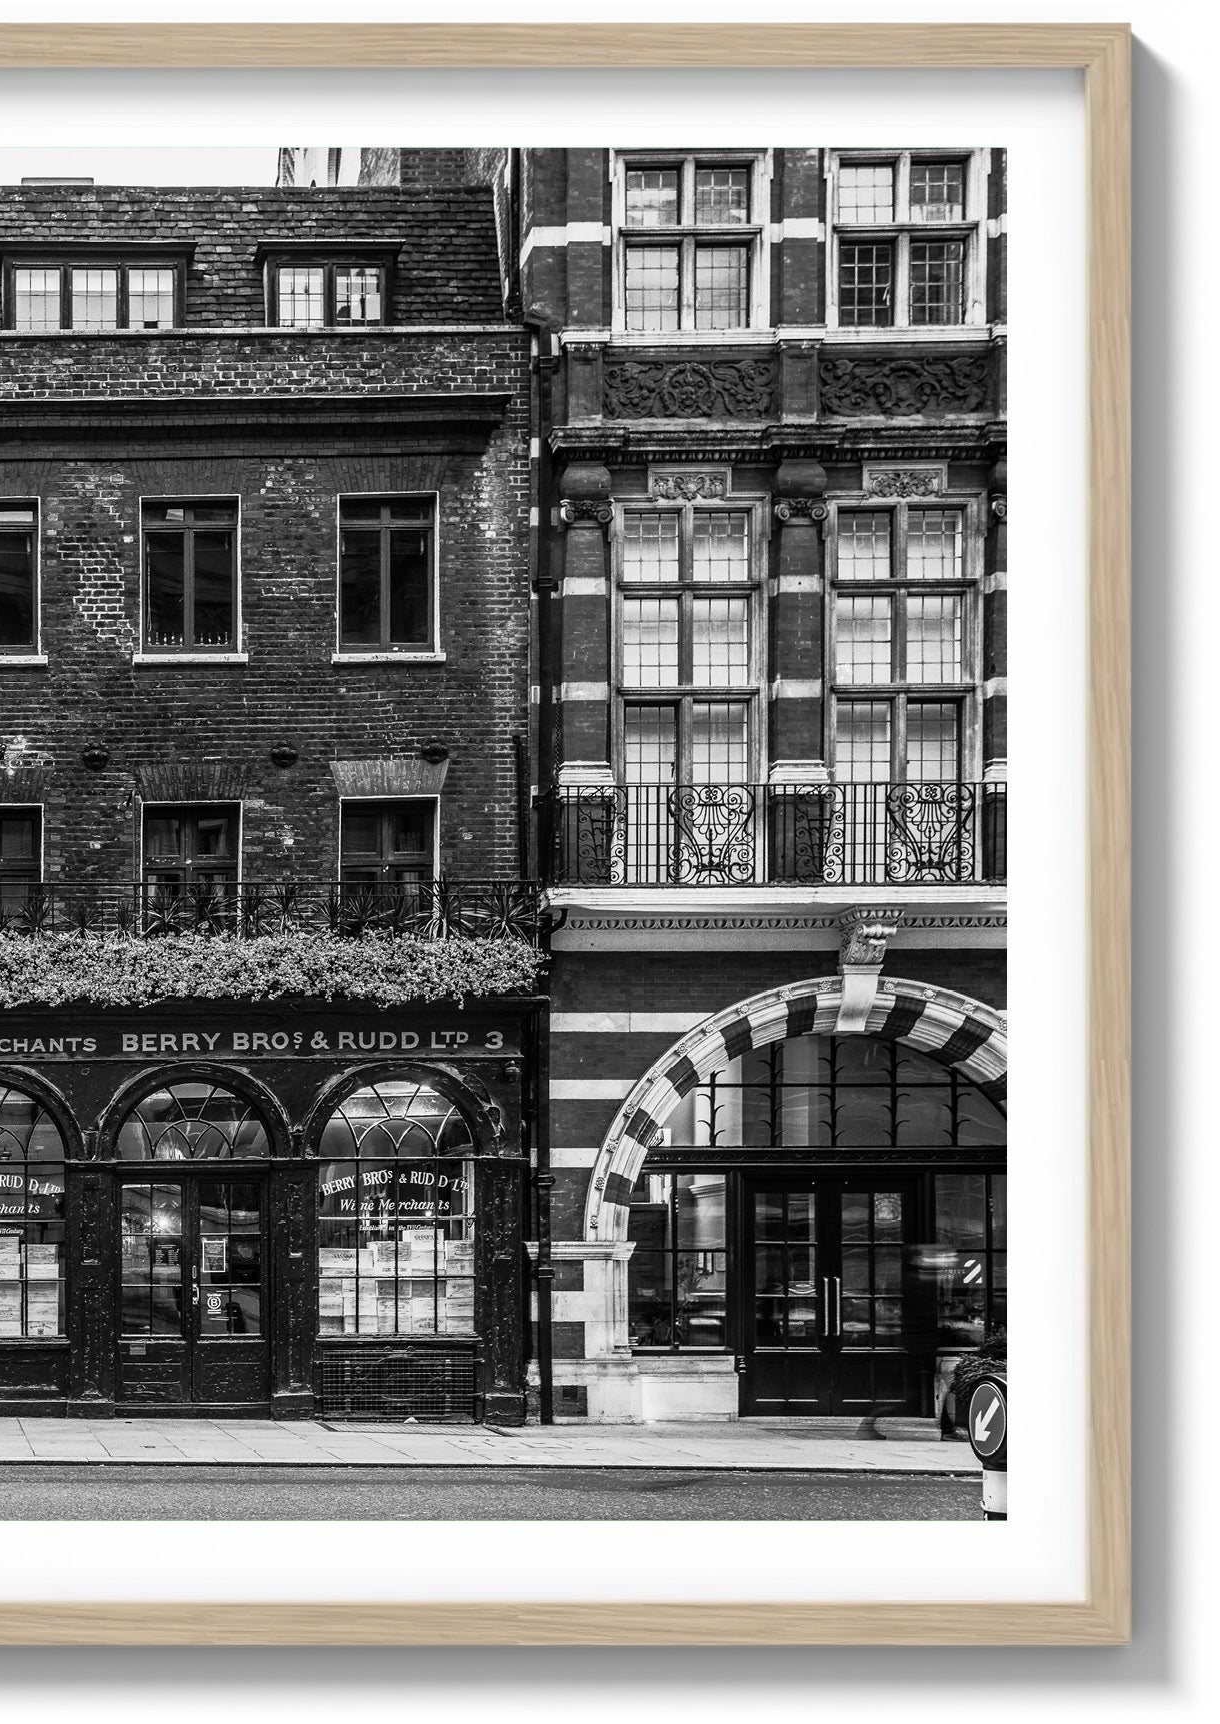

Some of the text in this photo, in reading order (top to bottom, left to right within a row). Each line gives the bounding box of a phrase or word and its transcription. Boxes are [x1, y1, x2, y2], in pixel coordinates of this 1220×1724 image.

[122, 1033, 221, 1052] BERRY
[310, 1031, 330, 1049] &
[338, 1031, 420, 1050] RUDD
[431, 1031, 469, 1049] LTD
[485, 1031, 504, 1050] 3
[44, 1182, 61, 1198] LTD
[321, 1175, 356, 1197] BERRY
[399, 1174, 407, 1184] &
[410, 1171, 448, 1188] RUDD
[452, 1179, 469, 1193] LTD
[340, 1199, 450, 1211] Wine Merchants
